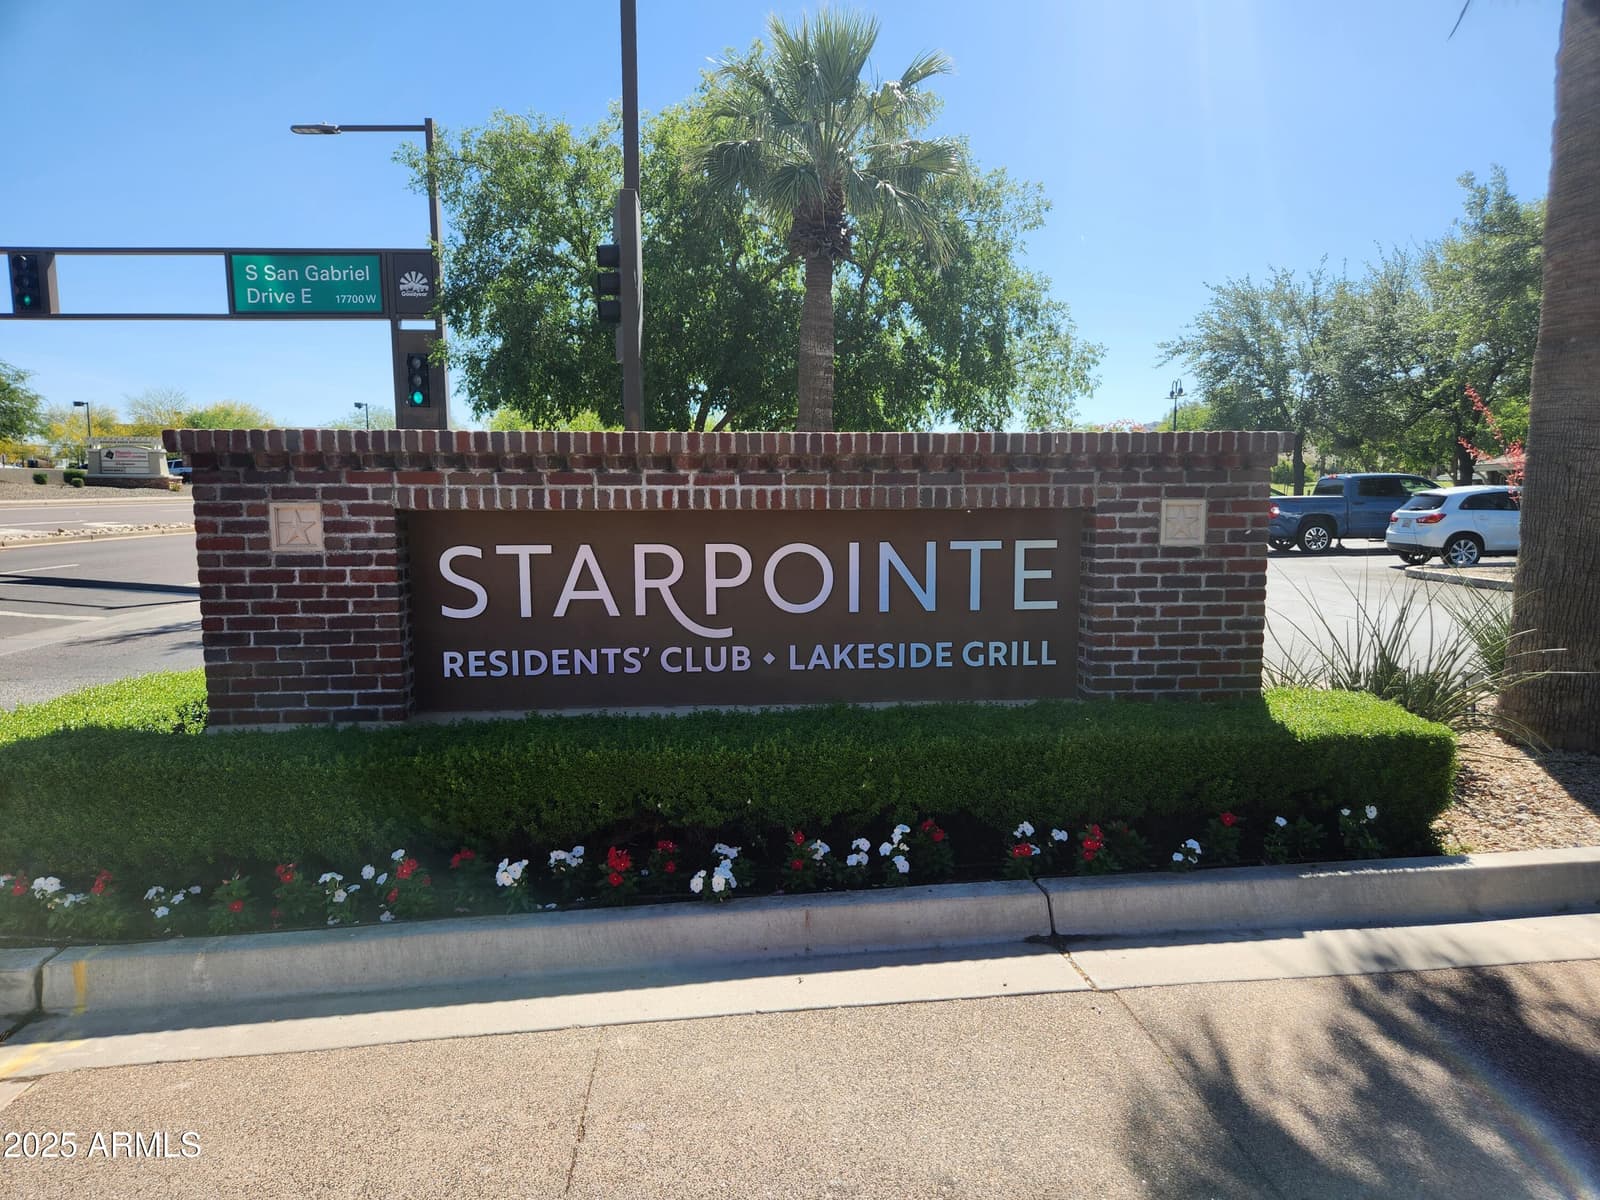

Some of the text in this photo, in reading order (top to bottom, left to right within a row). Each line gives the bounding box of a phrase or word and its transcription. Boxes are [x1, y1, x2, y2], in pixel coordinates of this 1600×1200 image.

[245, 264, 370, 281] S San Gabriel
[247, 288, 312, 304] Drive E
[438, 539, 1059, 639] STARPOINTE
[660, 645, 751, 673] CLUB
[788, 641, 953, 671] LAKESIDE
[962, 640, 1056, 668] GRILL
